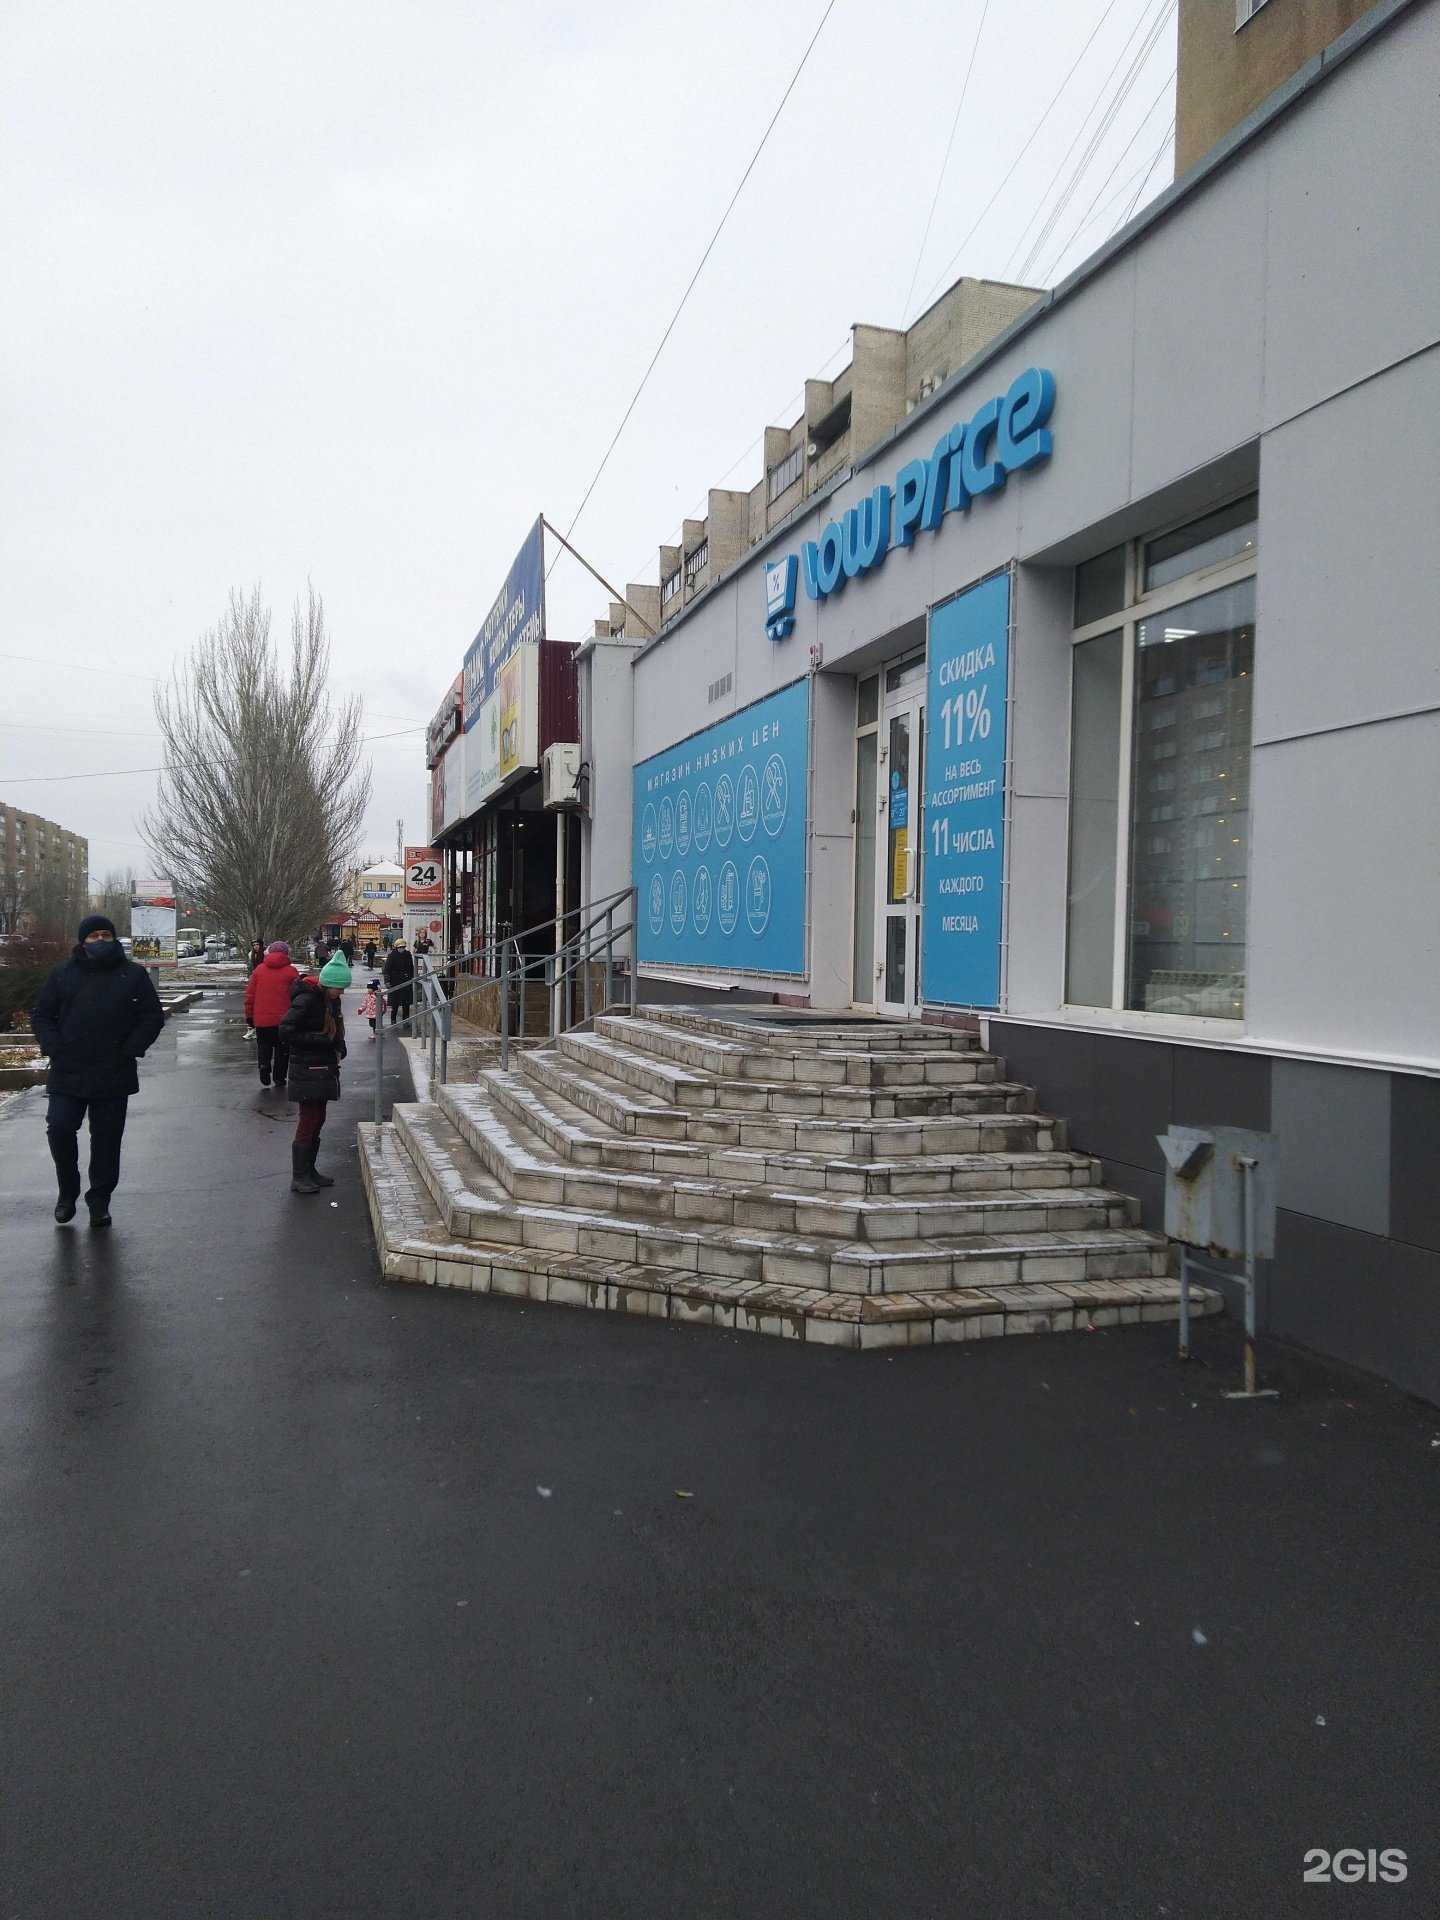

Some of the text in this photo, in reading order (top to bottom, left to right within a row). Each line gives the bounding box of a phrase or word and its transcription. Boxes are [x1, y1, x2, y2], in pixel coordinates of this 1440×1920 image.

[939, 642, 996, 686] СКИДКА
[940, 684, 991, 749] 11%
[647, 720, 779, 791] МАГАЗИН НИЗКИХ ЦЕН
[945, 758, 982, 781] НА ВЕСЬ
[931, 779, 996, 808] АССОРТИМЕНТ
[932, 817, 995, 856] 11 ЧИСЛА
[411, 866, 437, 882] 24
[939, 875, 984, 895] КАЖДОГО
[942, 915, 979, 934] МЕСЯЦА
